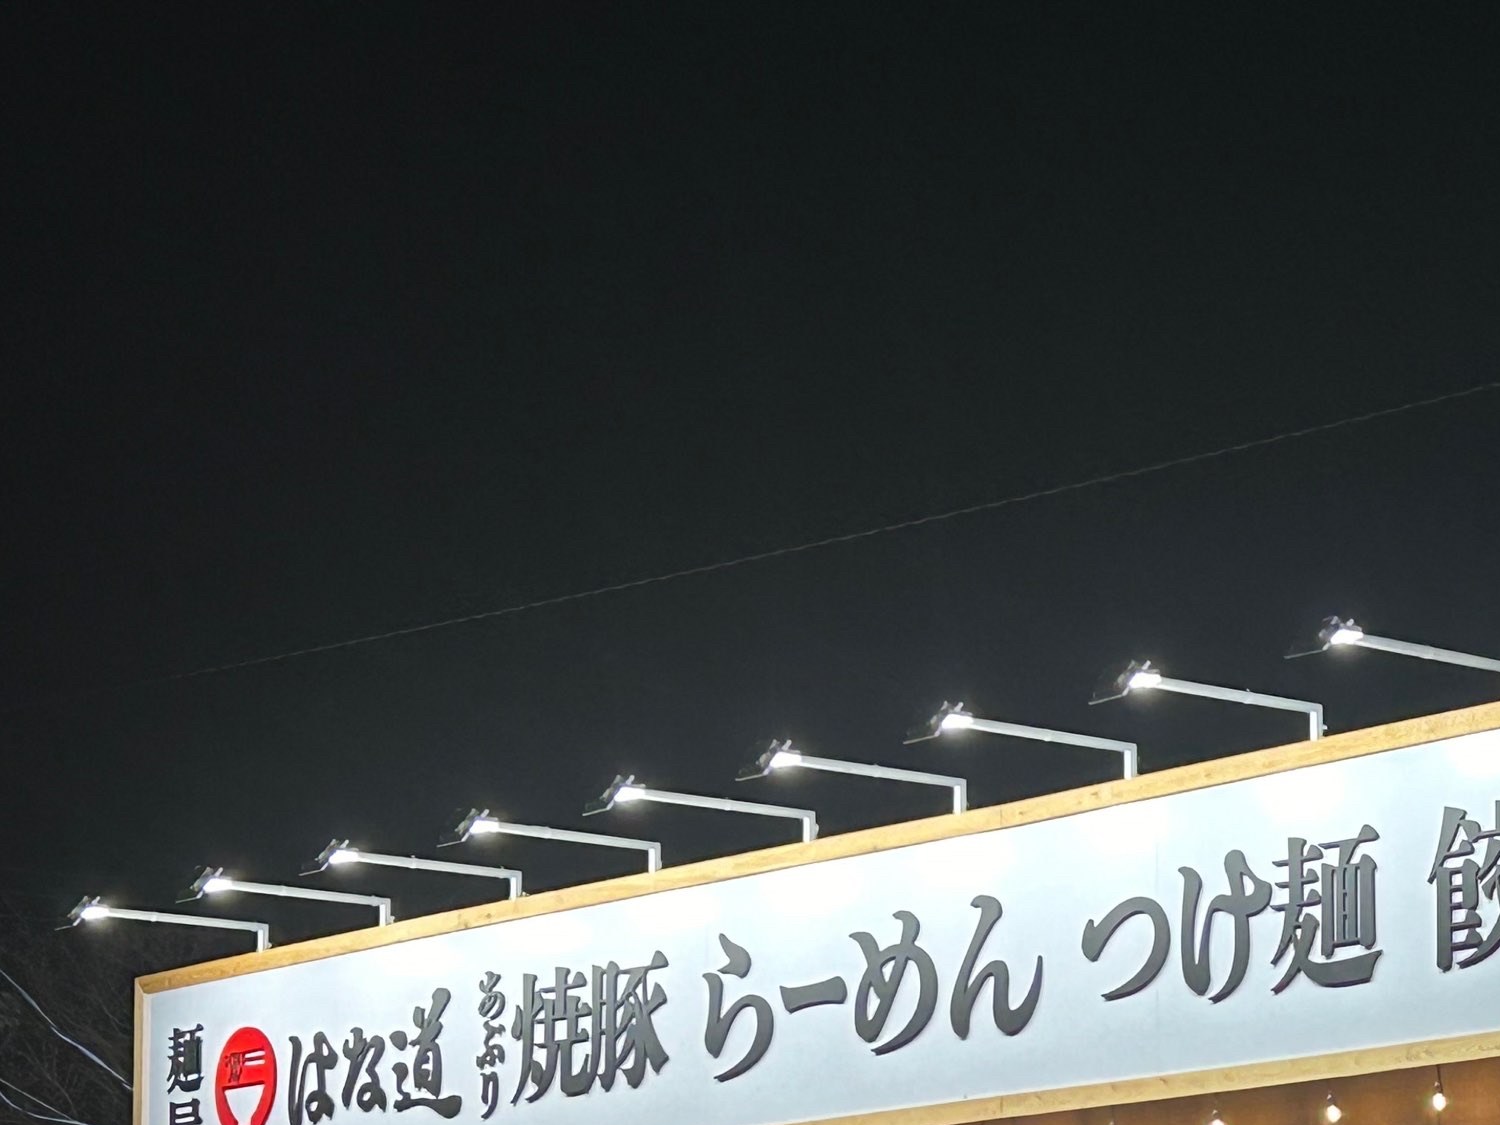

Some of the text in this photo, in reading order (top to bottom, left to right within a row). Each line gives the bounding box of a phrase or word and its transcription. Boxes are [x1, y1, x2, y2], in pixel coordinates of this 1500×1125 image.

[511, 951, 669, 1105] 焼豚
[703, 895, 1043, 1082] らーめん
[1082, 824, 1382, 1004] つけ麺
